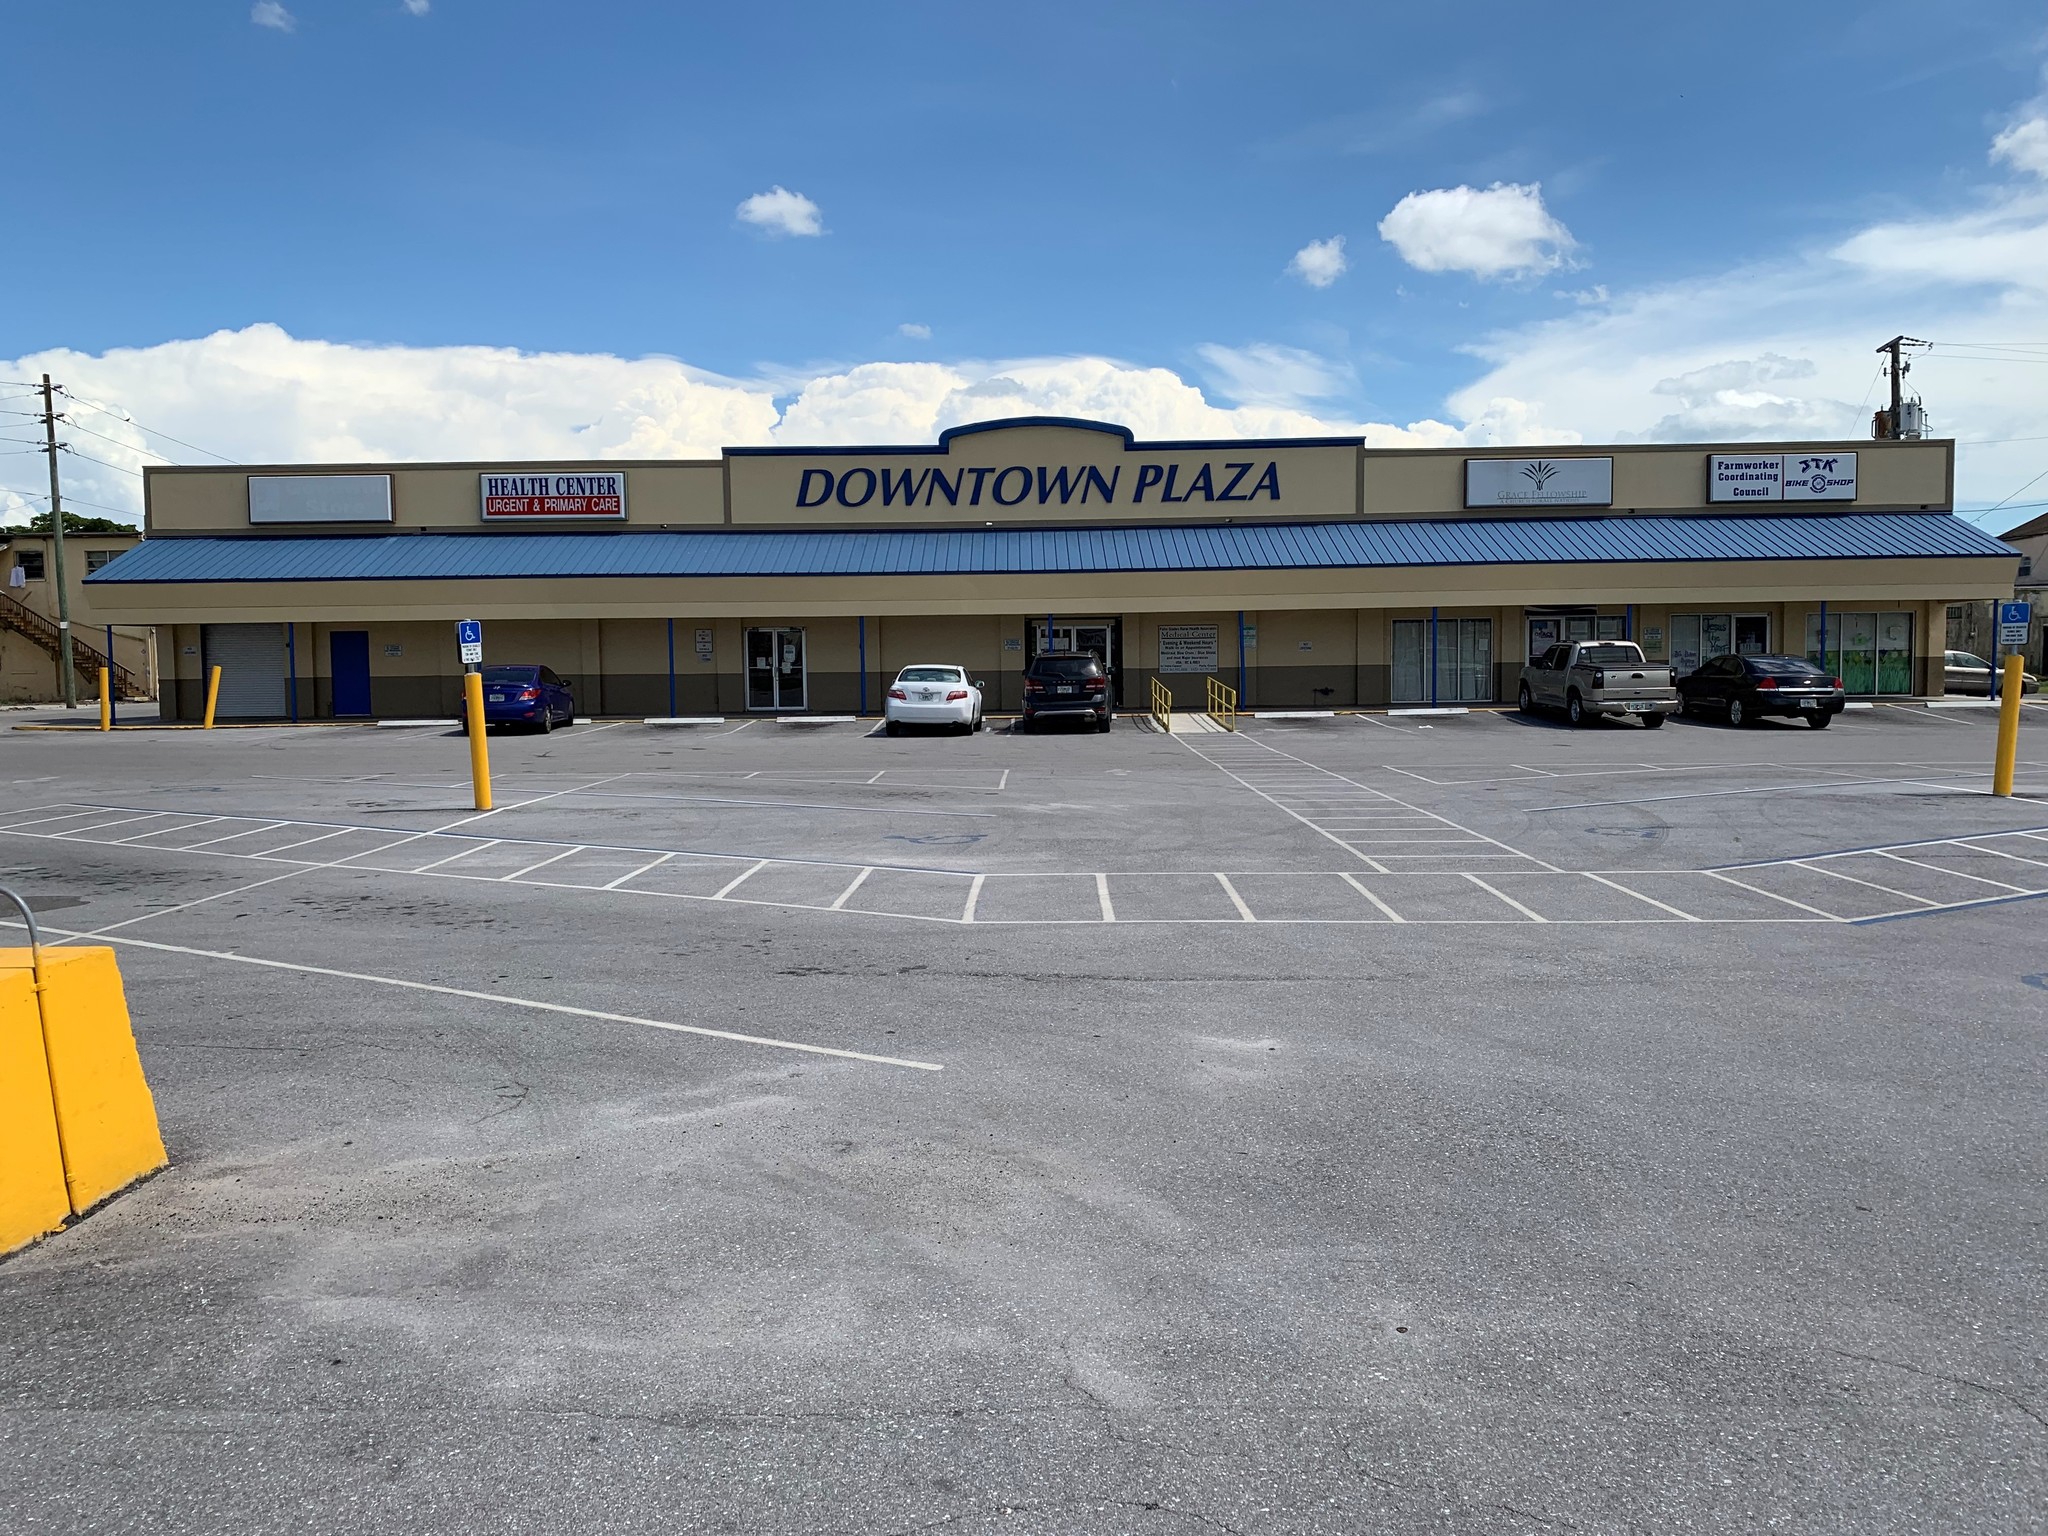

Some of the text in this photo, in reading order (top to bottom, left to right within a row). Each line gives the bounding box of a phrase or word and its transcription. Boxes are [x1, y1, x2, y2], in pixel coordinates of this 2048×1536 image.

[1717, 460, 1780, 471] Farmworker
[1718, 472, 1779, 482] Coordinating
[487, 476, 618, 497] HEALTH CENTER
[796, 461, 1281, 508] DOWNTOWN PLAZA
[1826, 479, 1855, 487] SHOP
[1497, 490, 1587, 499] GRACE FELLOWSHIP
[1733, 487, 1769, 496] Council
[488, 498, 619, 513] URGENT & PRIMARY CARE
